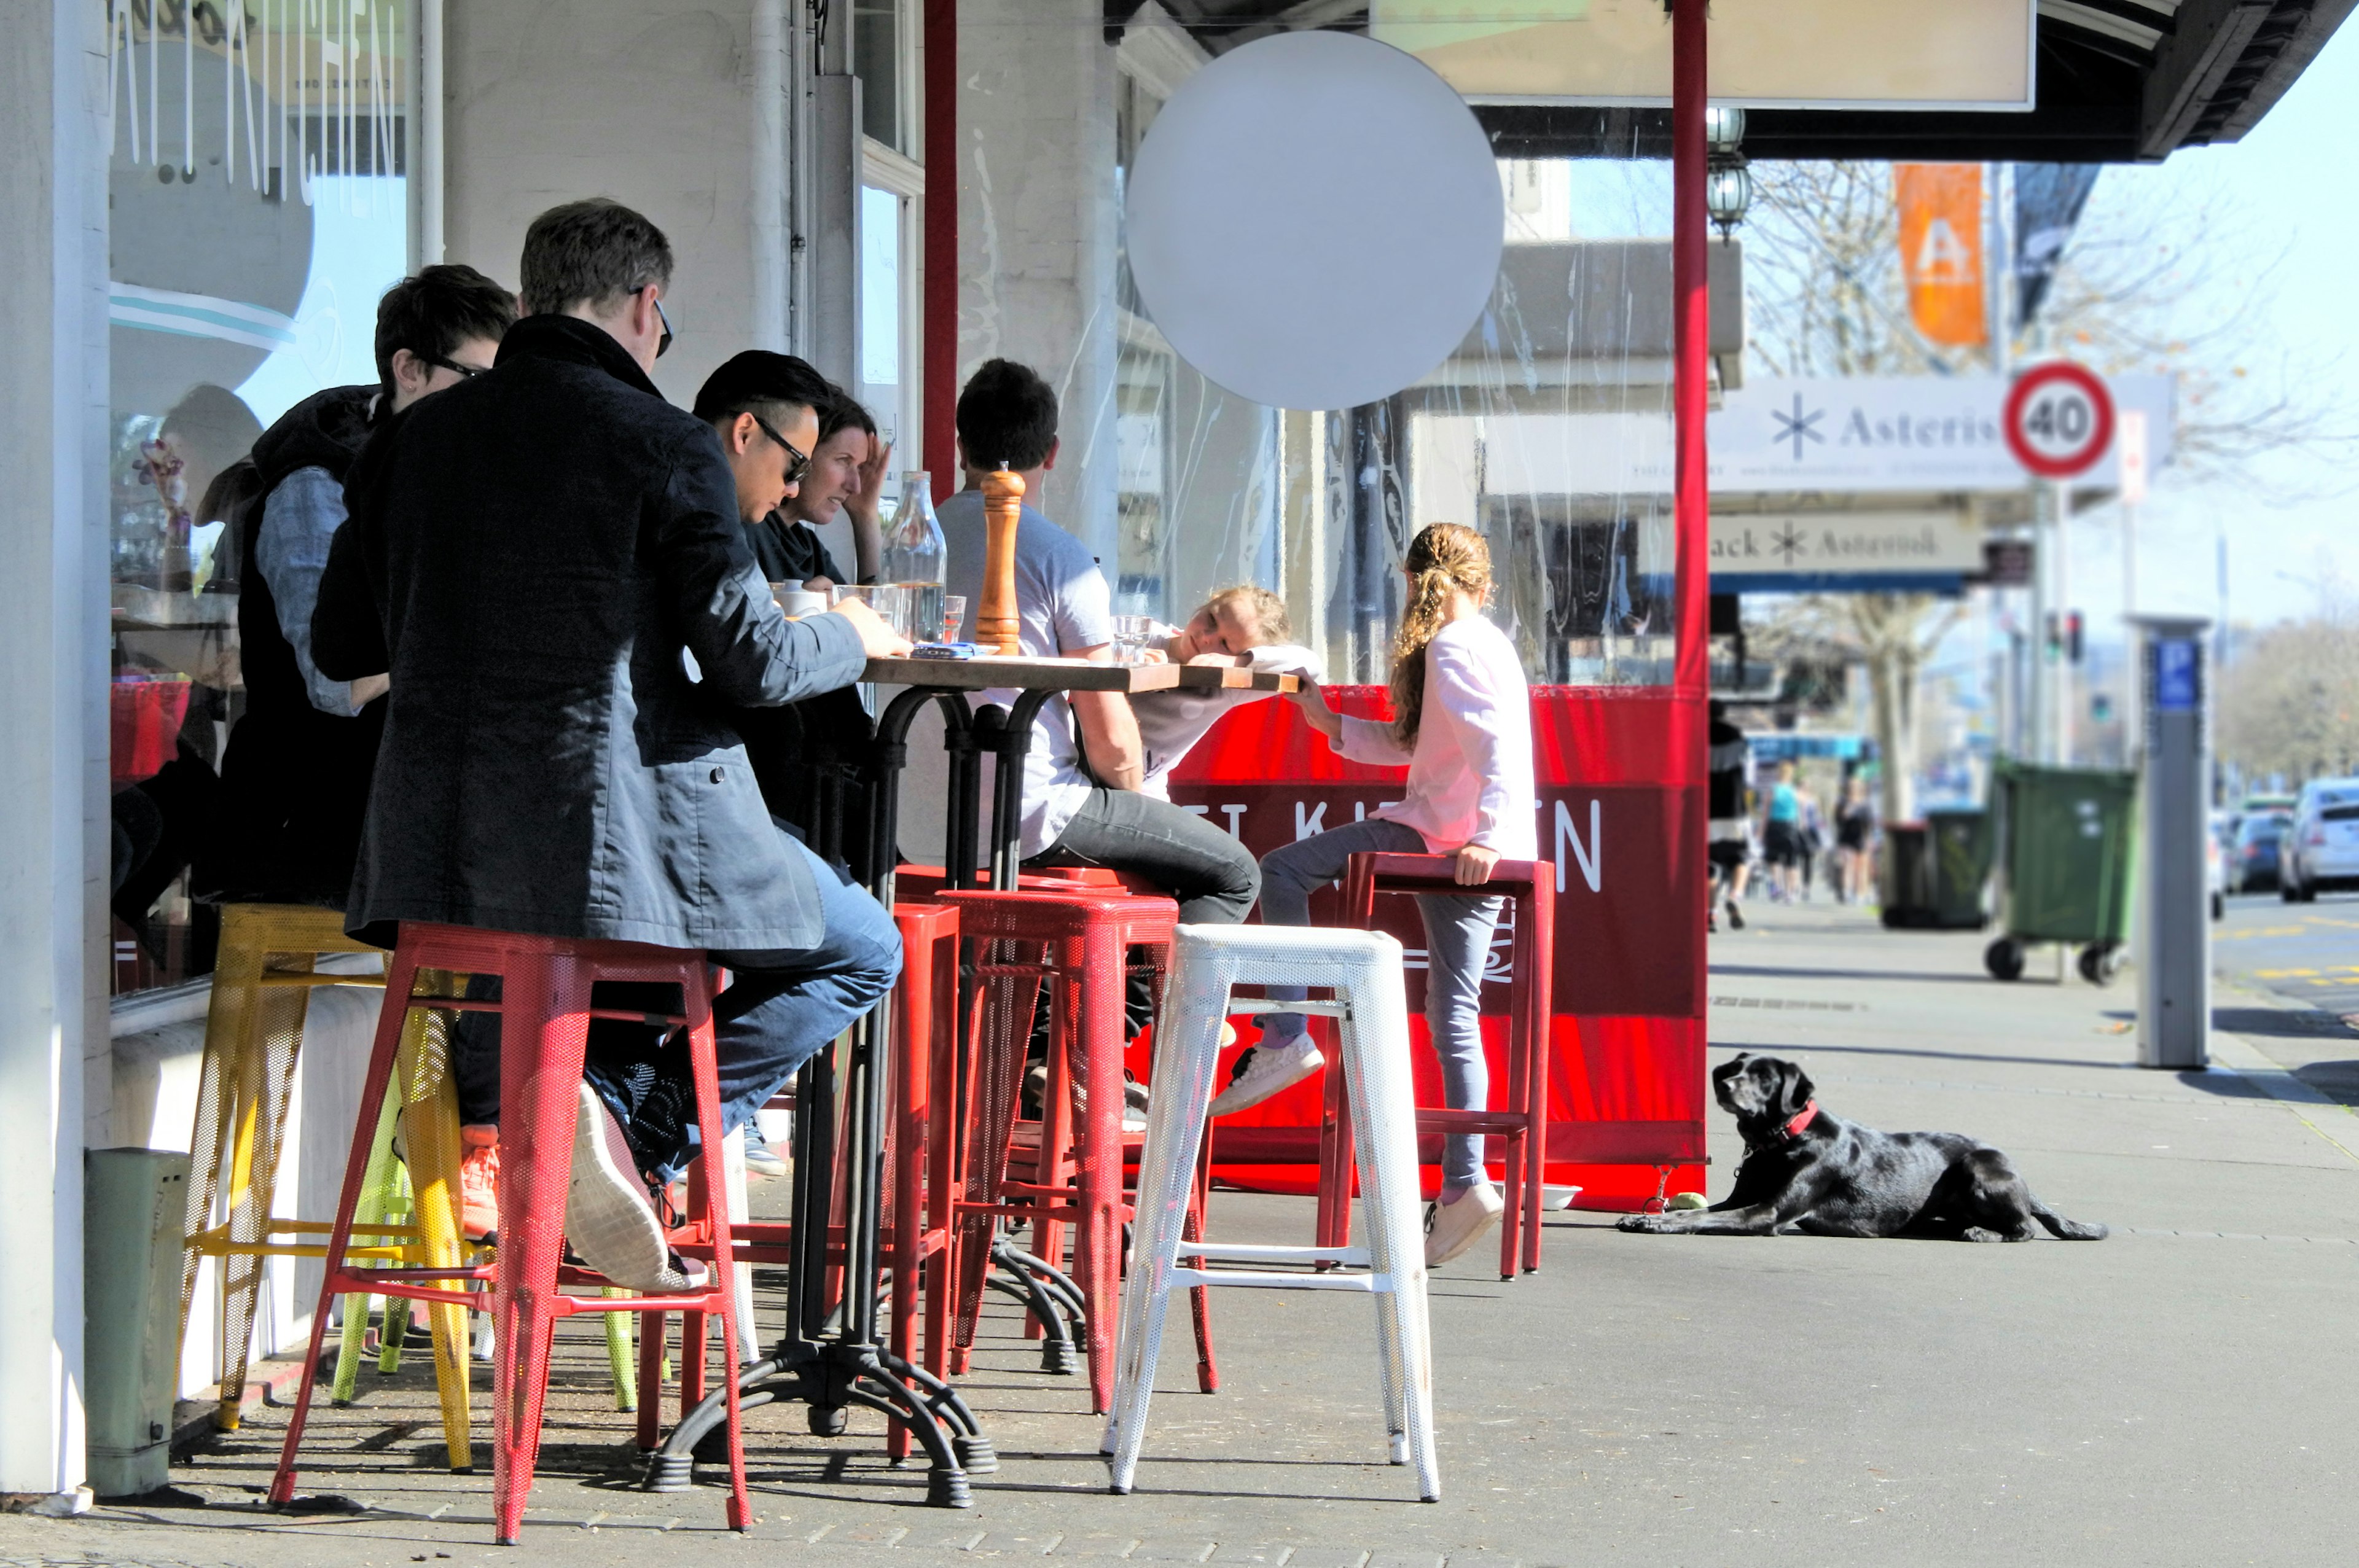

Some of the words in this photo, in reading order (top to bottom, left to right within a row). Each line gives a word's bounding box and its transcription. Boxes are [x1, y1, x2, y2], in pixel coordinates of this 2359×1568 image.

[1915, 219, 1970, 274] A
[1839, 405, 2000, 448] Asteris
[2025, 396, 2090, 442] 40
[1710, 528, 1759, 558] ack
